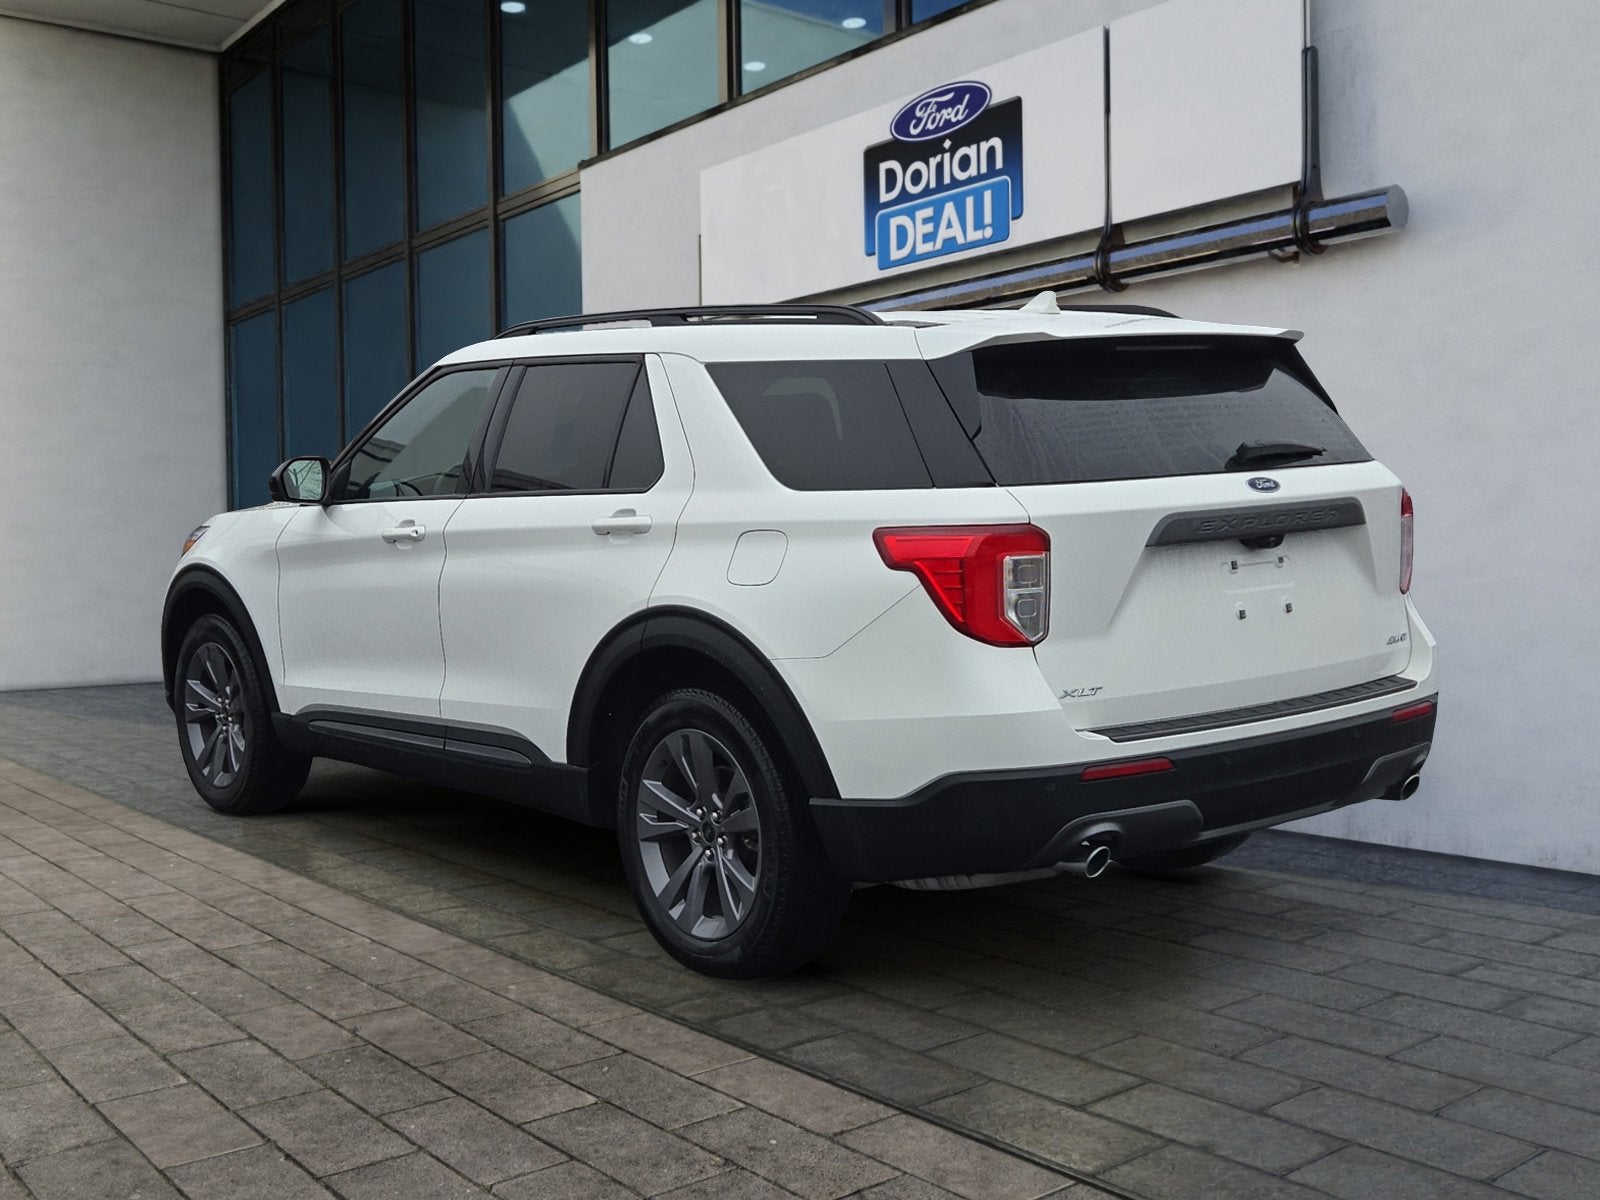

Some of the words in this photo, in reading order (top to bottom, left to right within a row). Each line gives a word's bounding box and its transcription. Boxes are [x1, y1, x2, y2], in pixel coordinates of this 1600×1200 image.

[909, 92, 970, 135] Ford
[879, 137, 1003, 203] Dorian
[889, 189, 993, 261] DEAL!
[1197, 509, 1341, 534] EXPLORER
[1058, 686, 1104, 700] XLT
